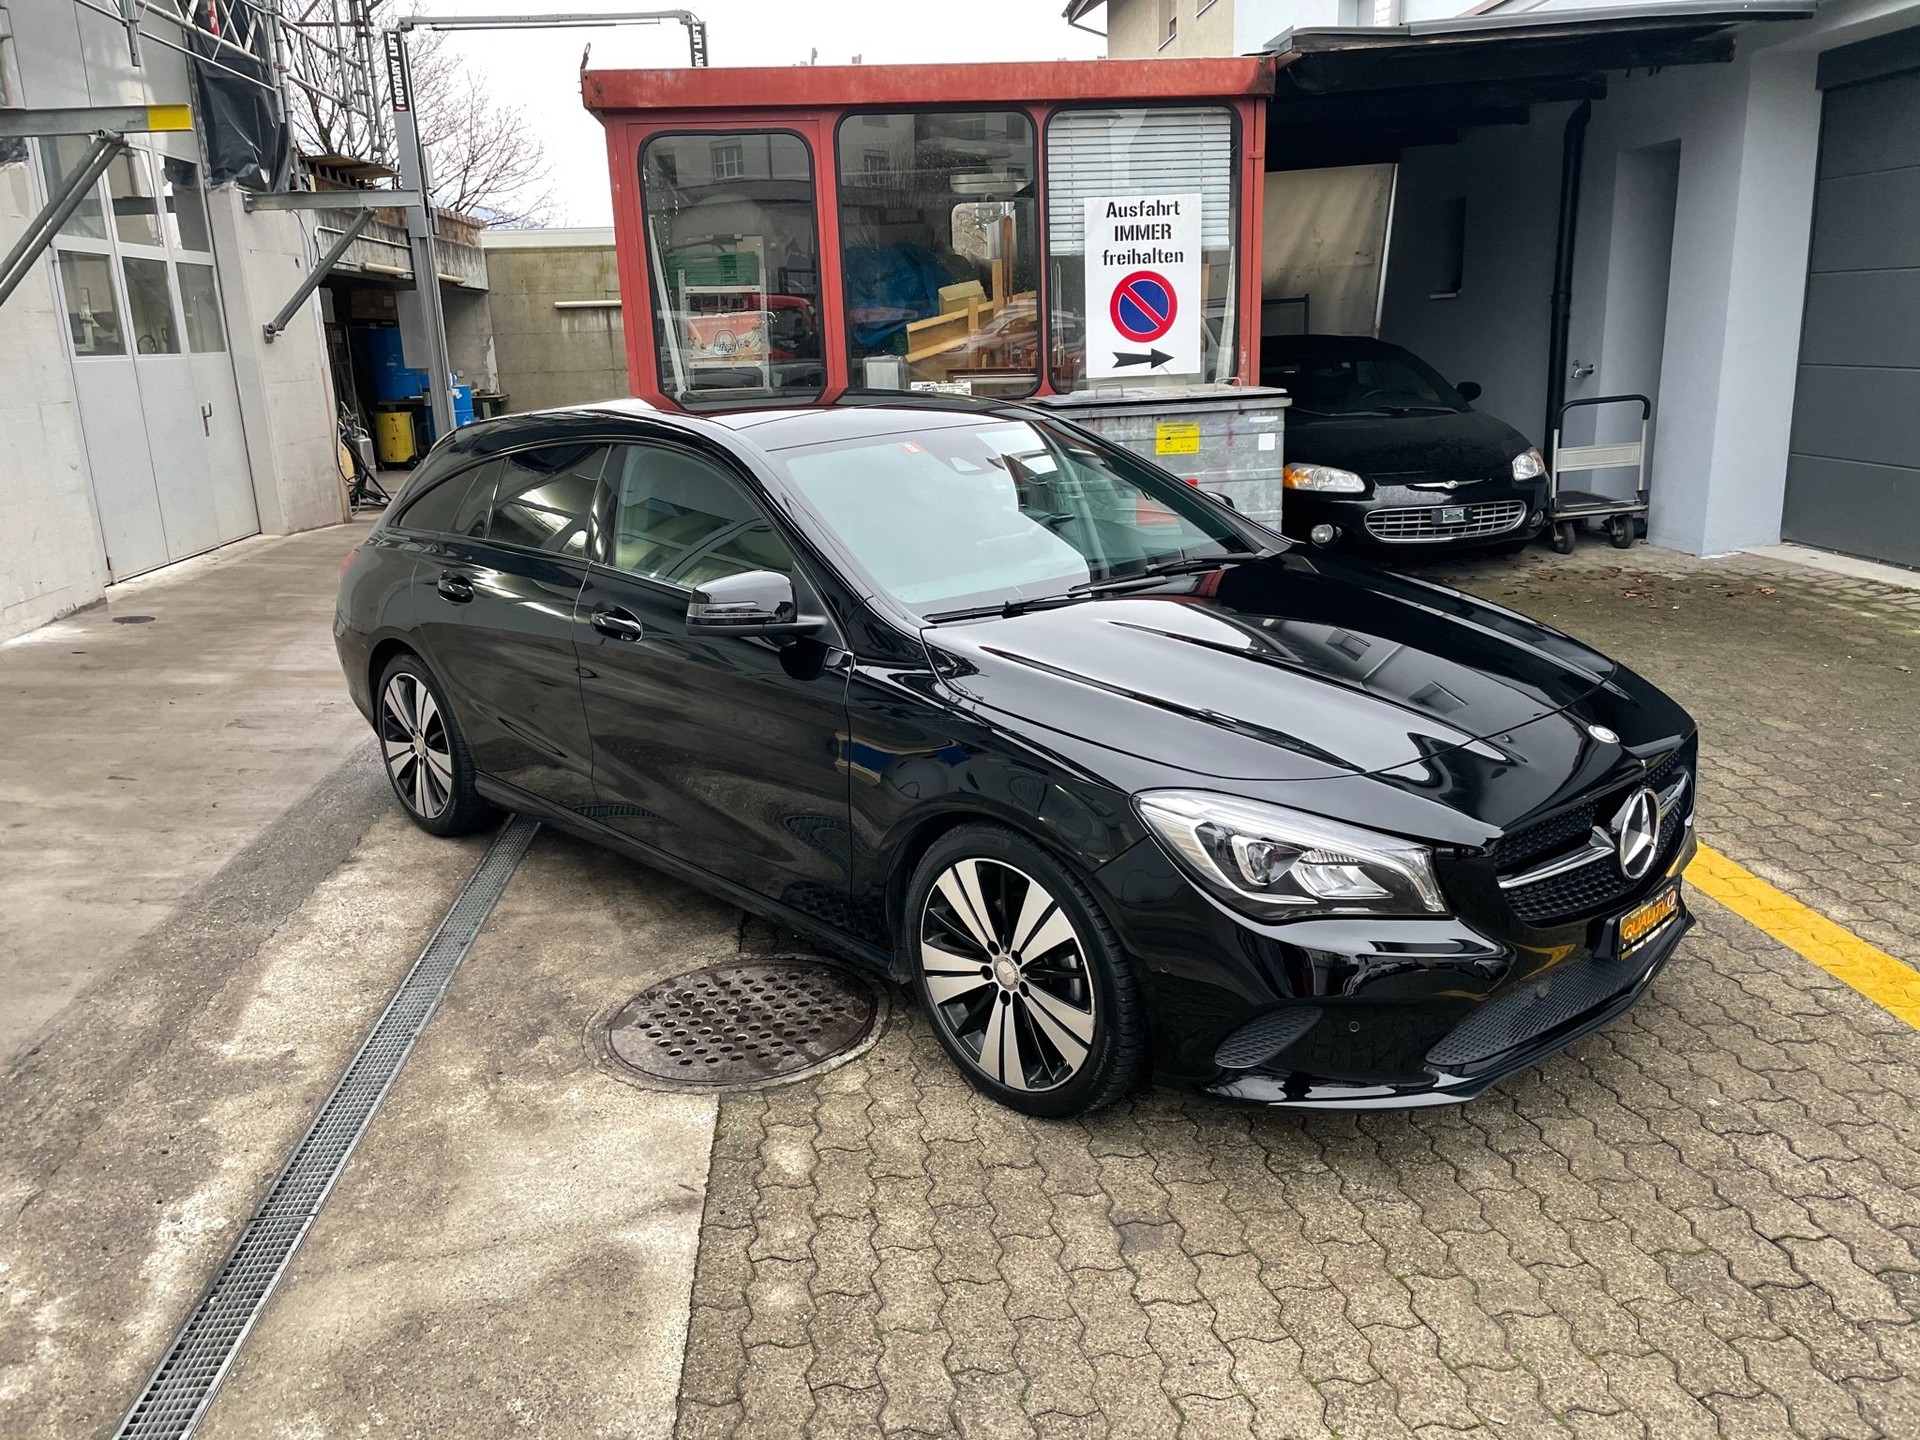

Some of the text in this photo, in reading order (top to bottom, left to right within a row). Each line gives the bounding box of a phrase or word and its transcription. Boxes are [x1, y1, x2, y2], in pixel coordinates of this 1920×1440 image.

[692, 24, 703, 49] LIFT
[387, 32, 406, 105] ROTARY LIFT
[1106, 199, 1180, 219] Ausfahrt
[1114, 223, 1172, 242] IMMER
[1102, 247, 1184, 266] freihalten
[1623, 896, 1667, 940] QUALITY
